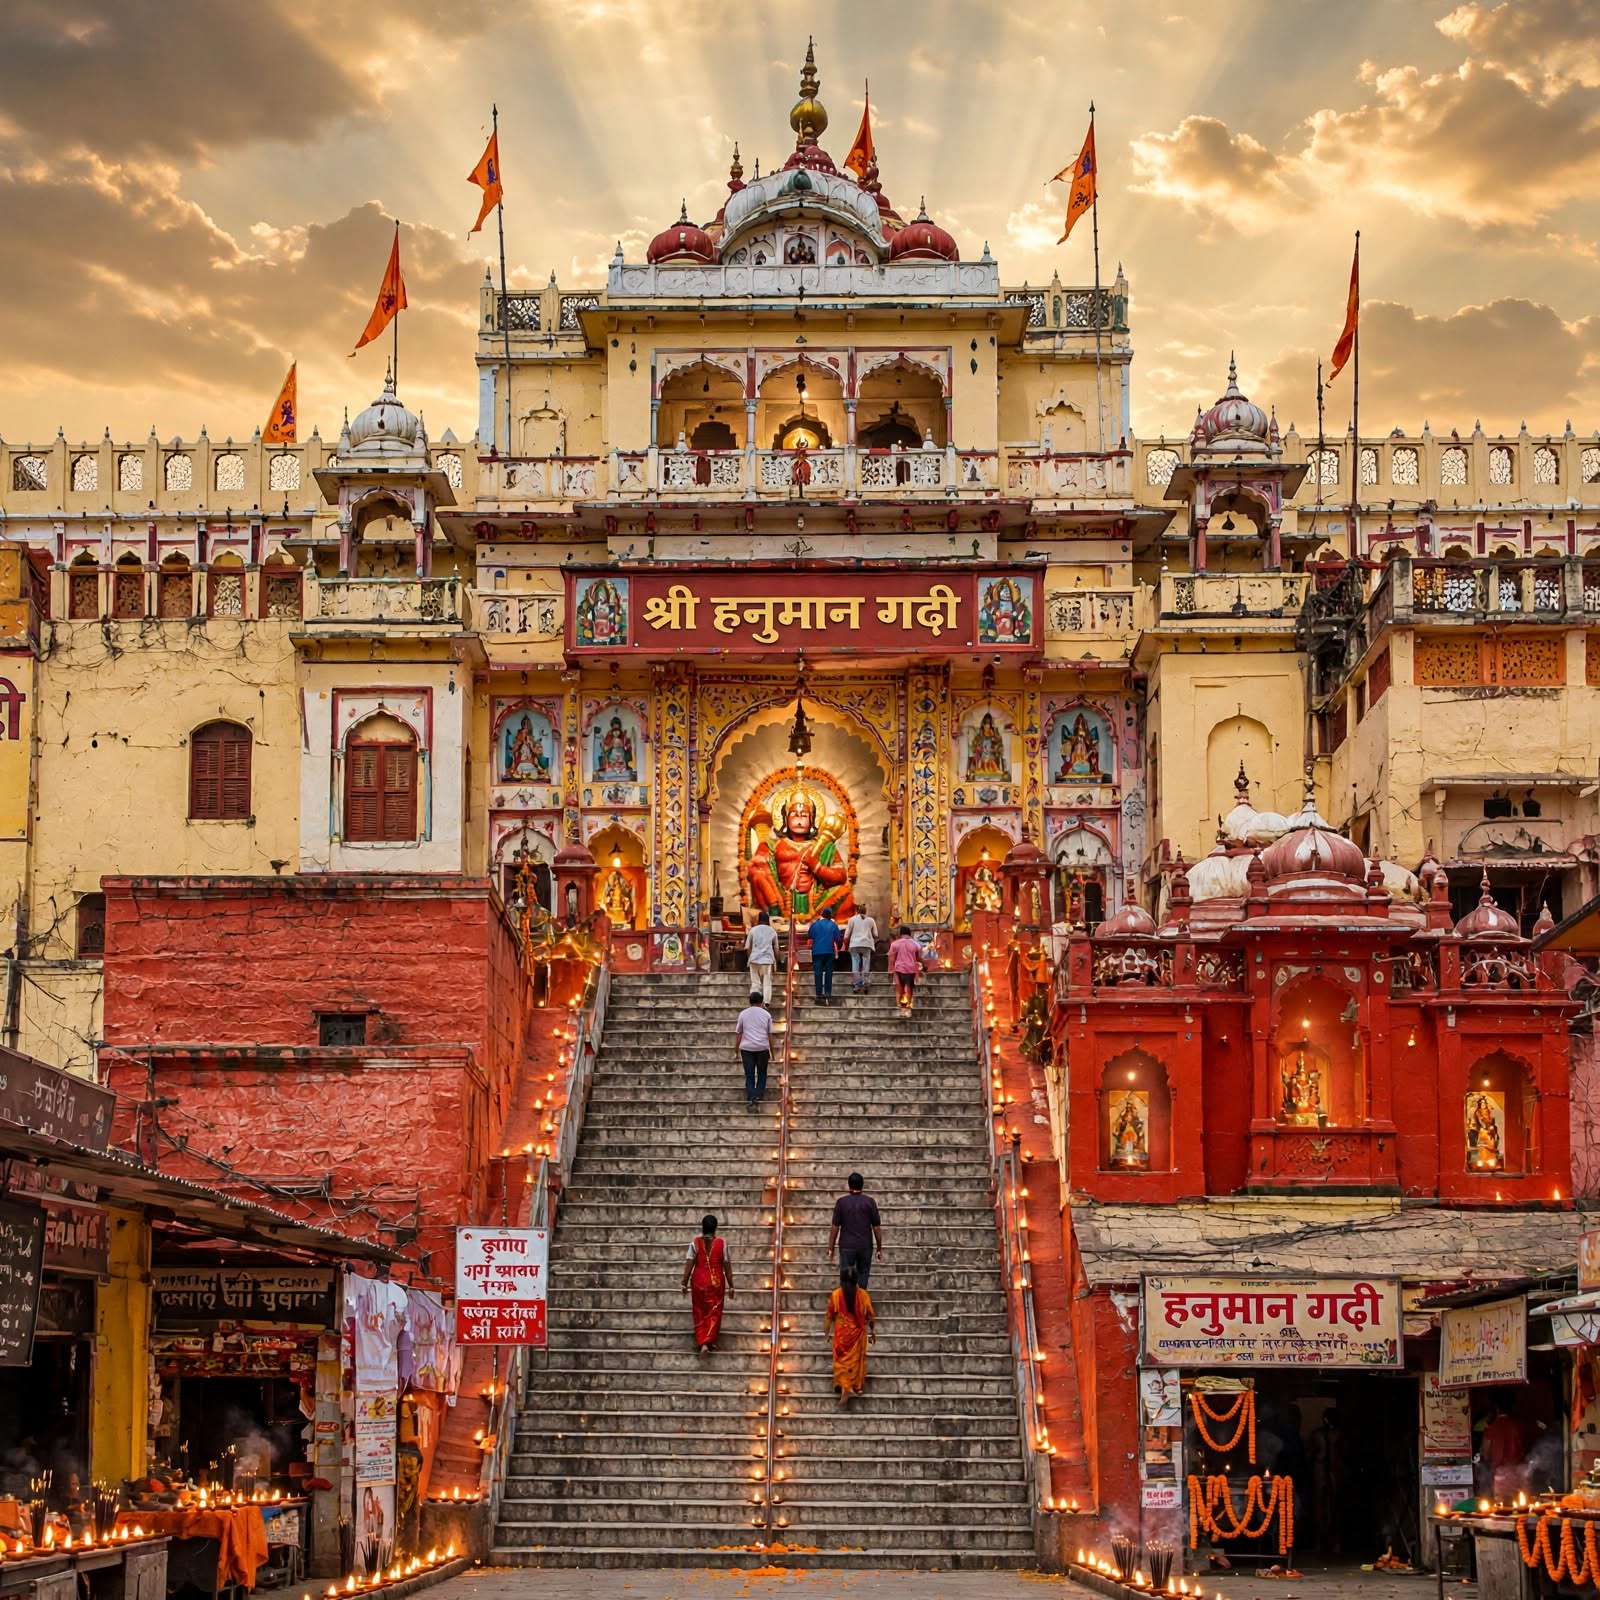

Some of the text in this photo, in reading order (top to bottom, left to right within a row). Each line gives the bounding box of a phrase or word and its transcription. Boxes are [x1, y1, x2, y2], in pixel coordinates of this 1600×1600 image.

[642, 584, 700, 630] श्री
[710, 597, 866, 644] हनुमान
[1161, 1292, 1298, 1336] हनुमान
